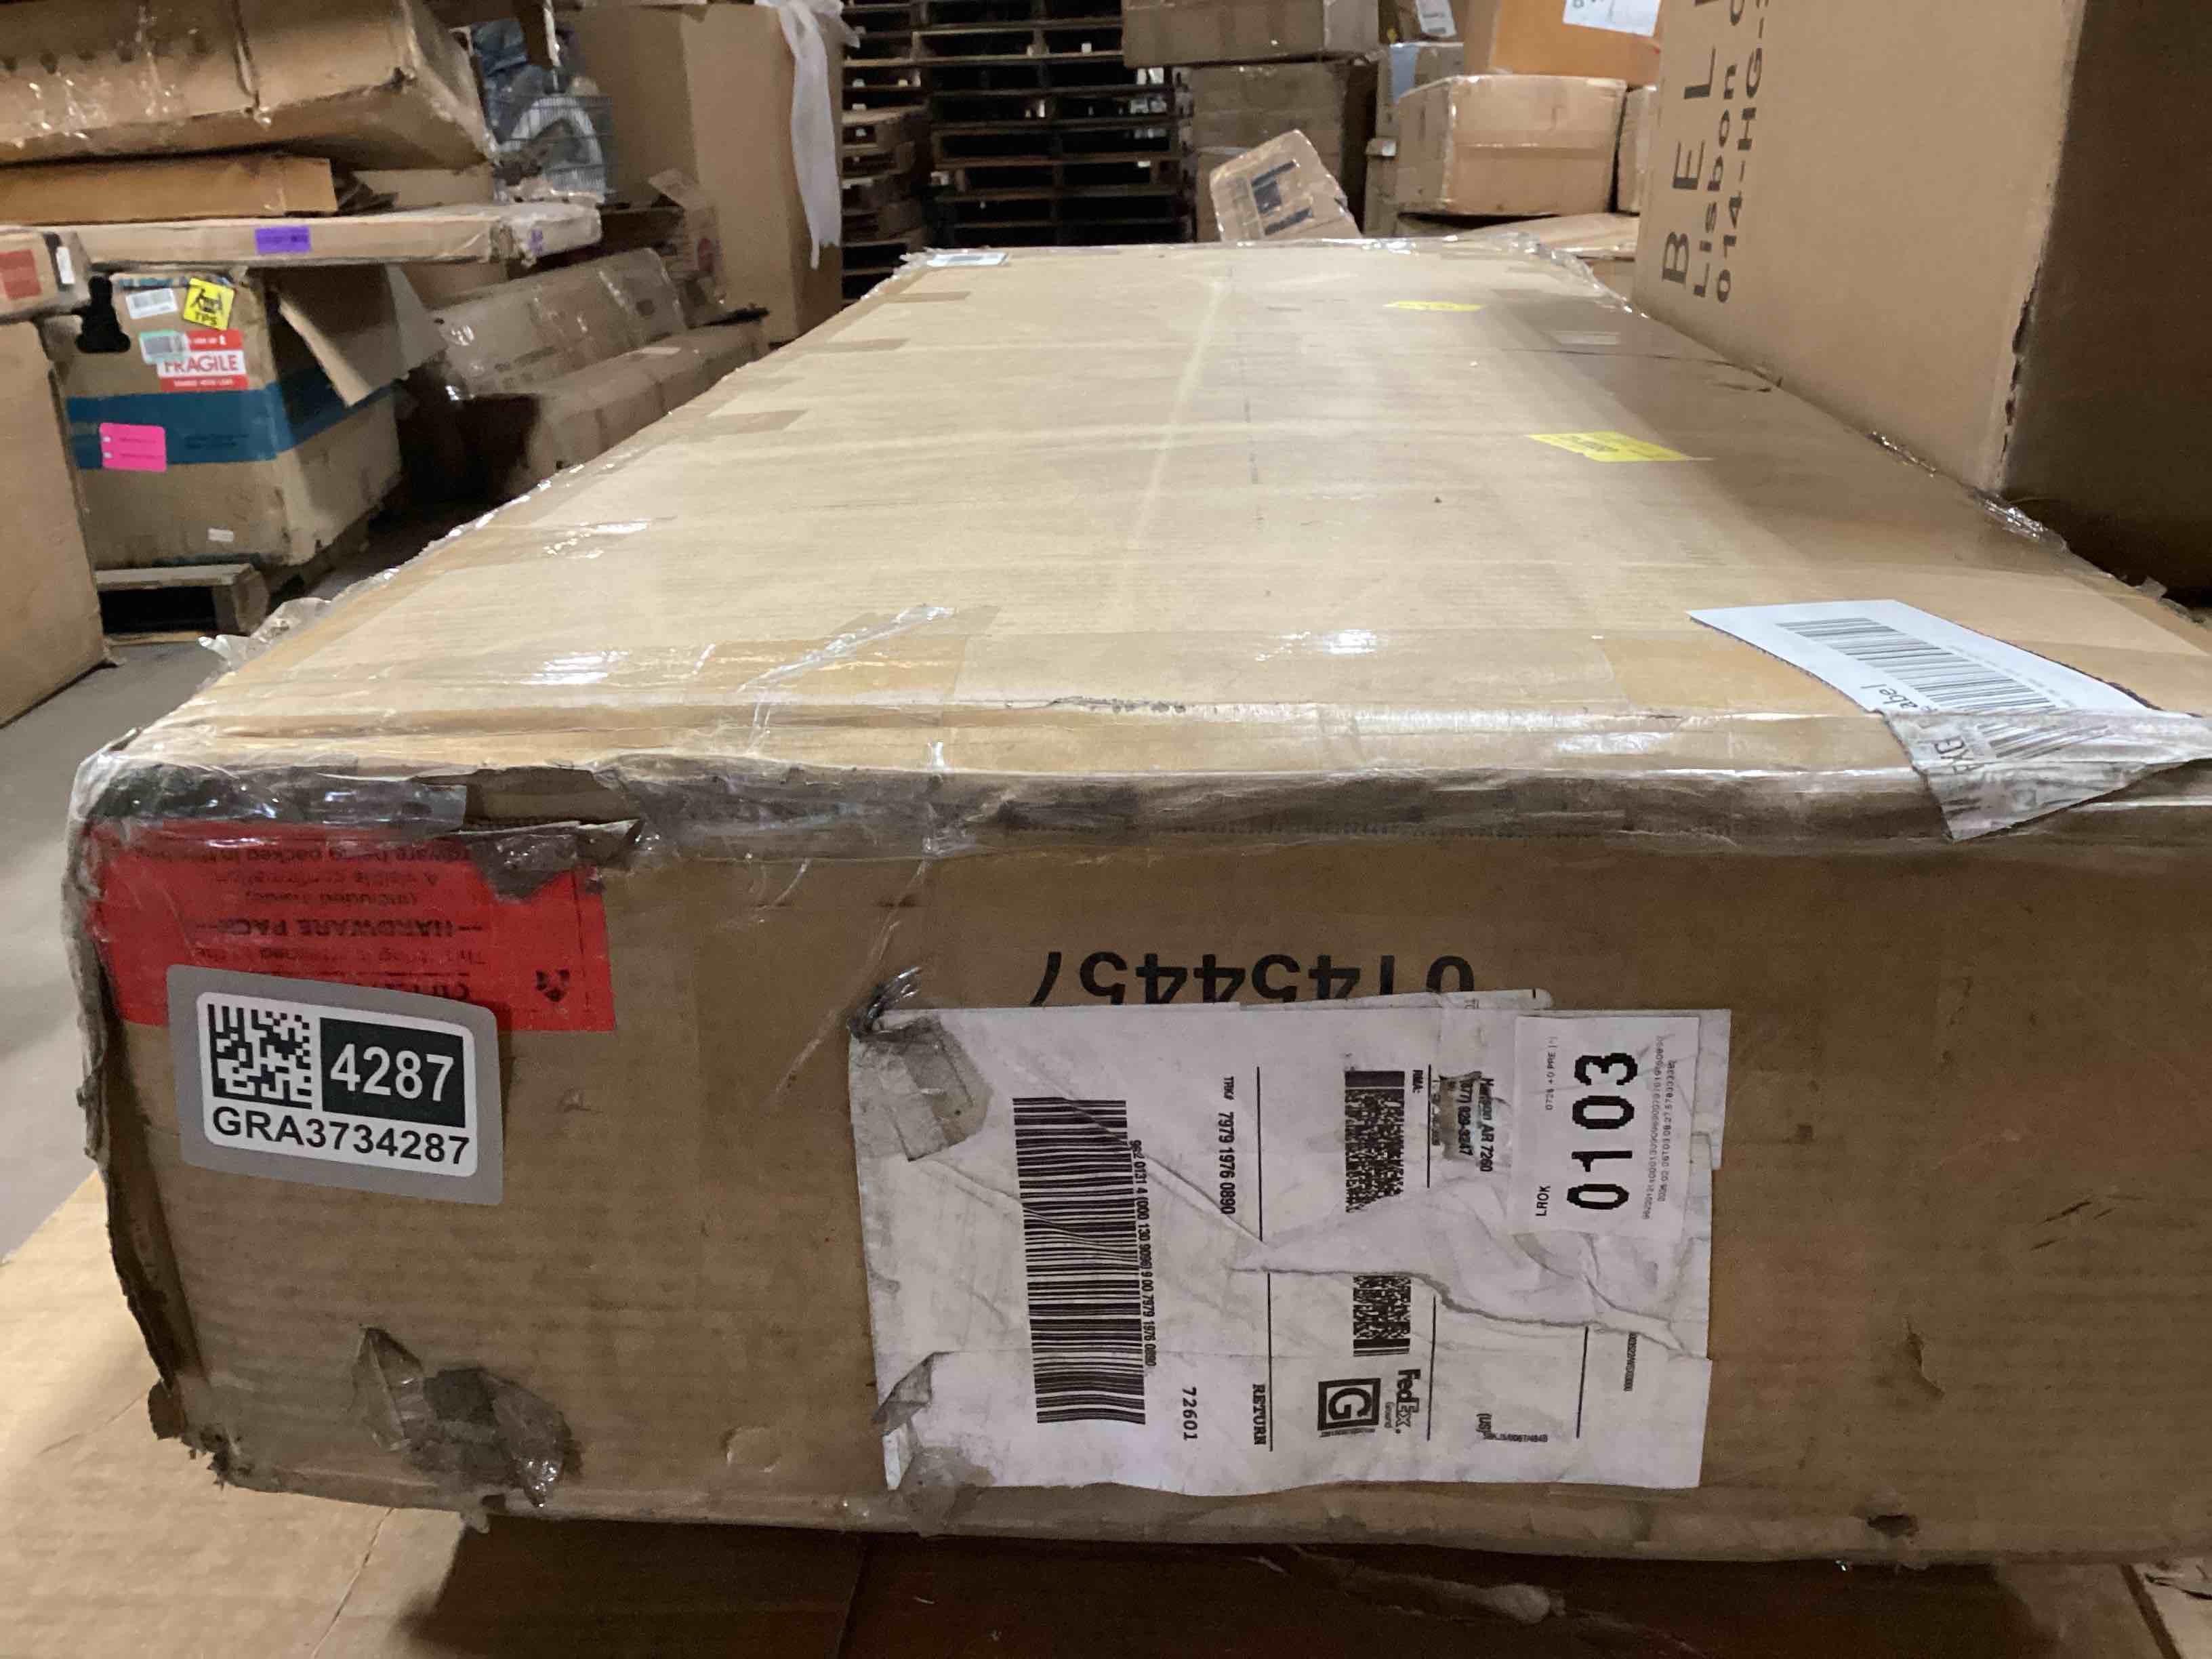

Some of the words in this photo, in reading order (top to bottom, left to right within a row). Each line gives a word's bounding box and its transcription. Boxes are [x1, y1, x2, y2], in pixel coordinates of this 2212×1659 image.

[1717, 0, 1768, 303] 014-HG-
[1694, 64, 1738, 298] Lisbon
[163, 354, 239, 372] FRAGILE
[330, 1042, 454, 1102] 4287
[212, 1106, 470, 1165] GRA3734287
[1218, 1111, 1235, 1144] 7979
[1566, 1052, 1638, 1210] 0103
[1218, 1147, 1236, 1179] 1976
[1219, 1182, 1236, 1214] 0890
[1536, 1185, 1551, 1216] LROK
[1143, 1295, 1155, 1317] 7979
[1143, 1321, 1155, 1341] 1976
[1183, 1387, 1198, 1441] 72601
[1252, 1384, 1267, 1445] RETURN
[1328, 1387, 1372, 1420] G
